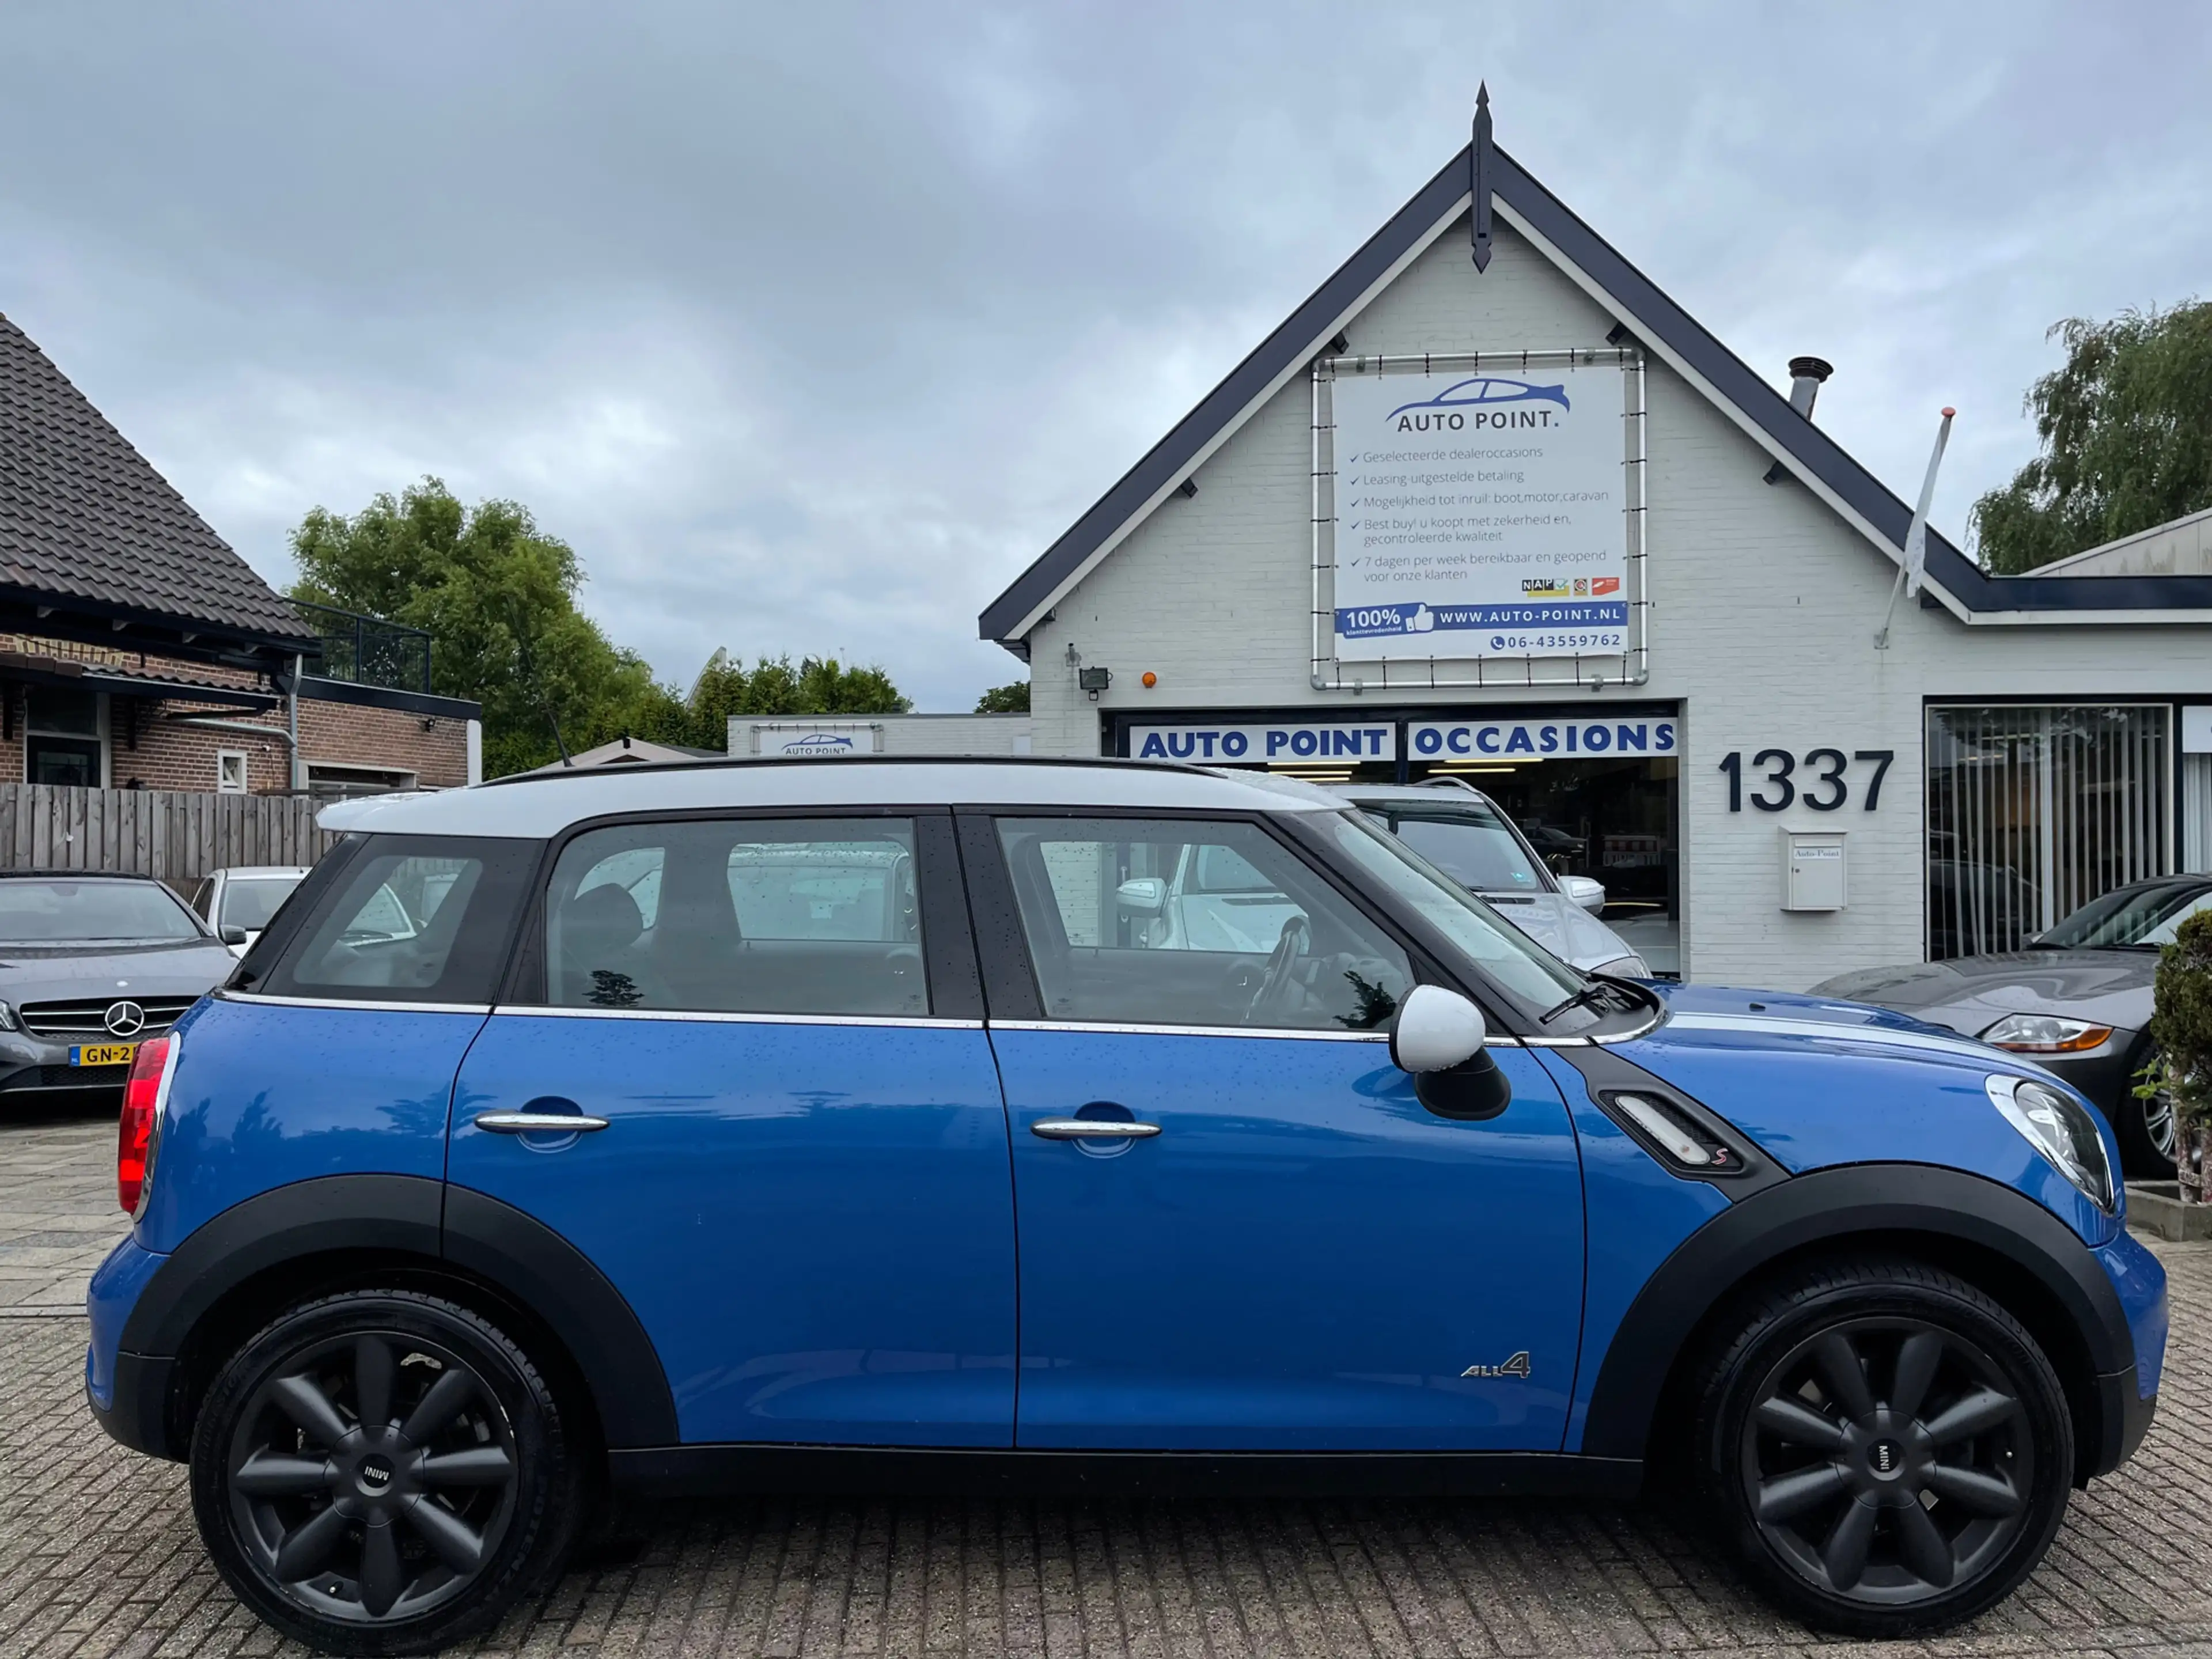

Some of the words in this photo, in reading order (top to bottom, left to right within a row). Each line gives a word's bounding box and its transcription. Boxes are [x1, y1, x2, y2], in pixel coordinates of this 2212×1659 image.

[1397, 414, 1464, 432] AUTO
[1475, 410, 1559, 430] POINT.
[1363, 450, 1446, 463] Geselecteerde
[1449, 449, 1543, 460] dealeroccasions
[1478, 471, 1524, 483] betaling
[1364, 496, 1435, 510] Mogelijkheid
[1439, 496, 1455, 505] tot
[1459, 494, 1491, 505] inruil:
[1364, 520, 1389, 530] Best
[1392, 519, 1416, 531] buy!
[1420, 521, 1427, 529] u
[1431, 518, 1464, 529] koopt
[1467, 517, 1490, 527] met
[1494, 516, 1551, 527] zekerheid
[1363, 533, 1452, 547] gecontroleerde
[1456, 532, 1503, 541] kwaliteit
[1365, 557, 1372, 567] 7
[1374, 556, 1410, 569] dagen
[1414, 558, 1433, 567] per
[1436, 554, 1467, 565] week
[1470, 554, 1532, 564] bereikbaar
[1536, 554, 1551, 562] en
[1554, 551, 1607, 565] geopend
[1363, 573, 1389, 582] voor
[1393, 572, 1422, 581] onze
[1425, 570, 1468, 581] klanten
[1523, 579, 1553, 590] NAP
[1347, 608, 1401, 628] 100%
[1440, 608, 1620, 623] WWW.AUTO-POINT.NL
[1508, 635, 1620, 647] 06-43559762
[1139, 731, 1248, 757] AUTO
[1266, 729, 1388, 756] POINT
[1414, 724, 1675, 754] OCCASIONS
[1719, 748, 1893, 812] 1337
[1795, 849, 1839, 857] Auto-Point
[1711, 1148, 1728, 1165] S
[1879, 1445, 1889, 1469] MINI
[364, 1466, 389, 1480] MINI
